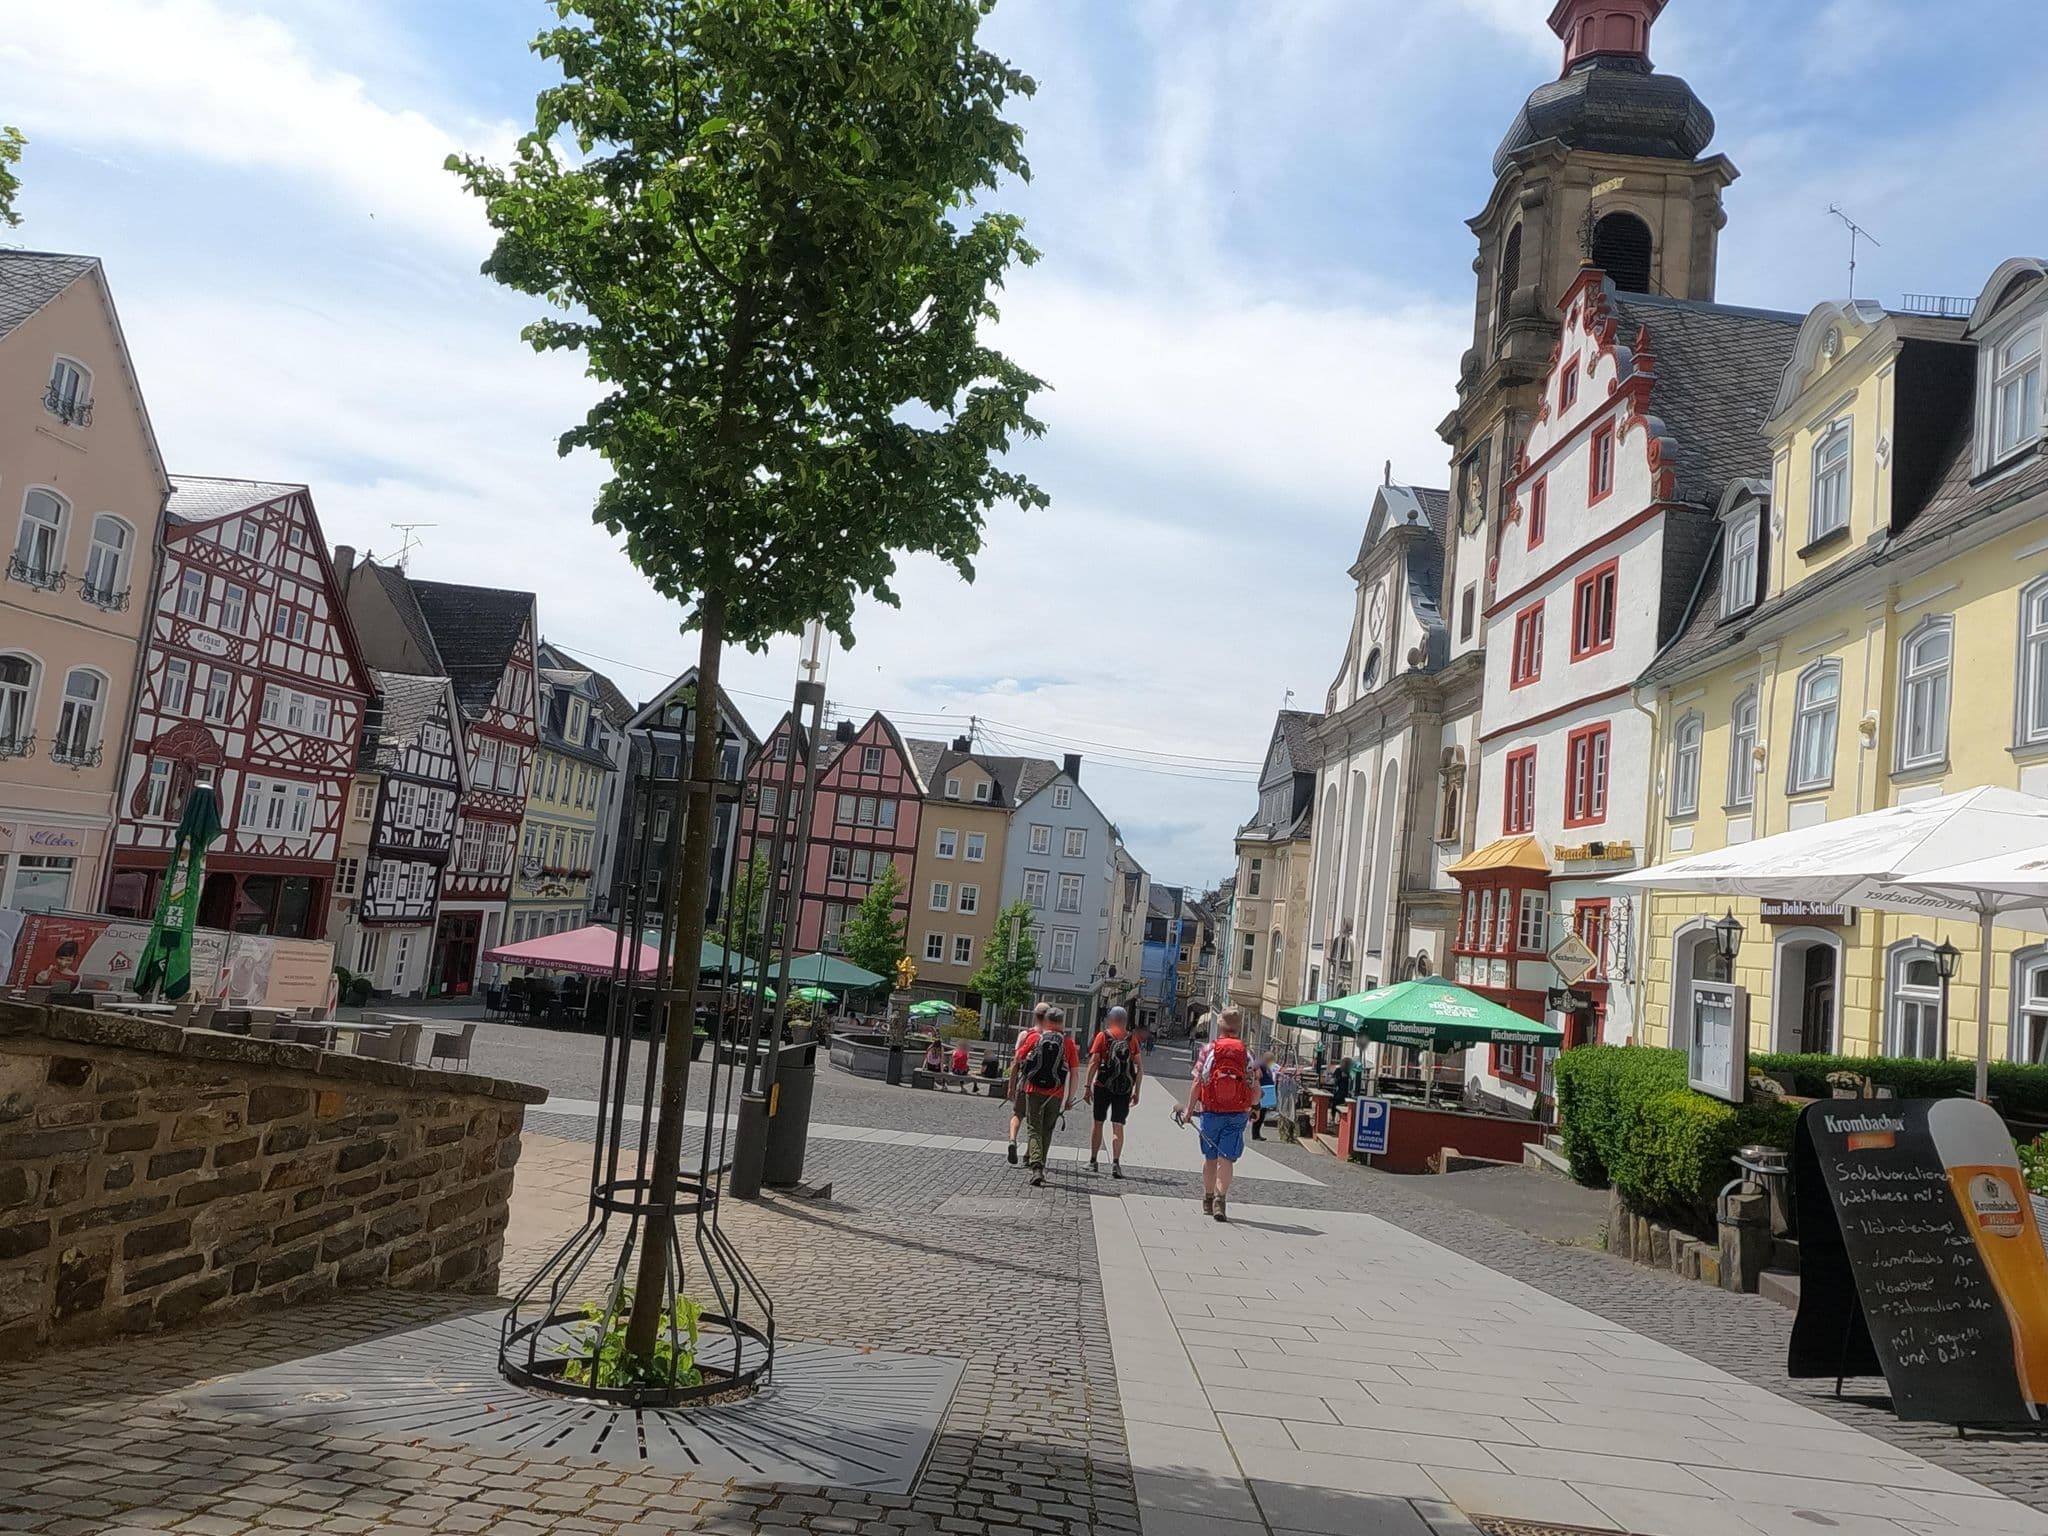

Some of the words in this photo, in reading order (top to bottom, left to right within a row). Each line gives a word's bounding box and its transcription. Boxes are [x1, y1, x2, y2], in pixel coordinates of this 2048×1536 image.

[1761, 902, 1781, 915] Haus
[1388, 1021, 1436, 1037] Hachenburger
[1491, 1029, 1541, 1045] Hachenburger
[1362, 1101, 1383, 1127] P
[1824, 1113, 1905, 1133] Krombacher
